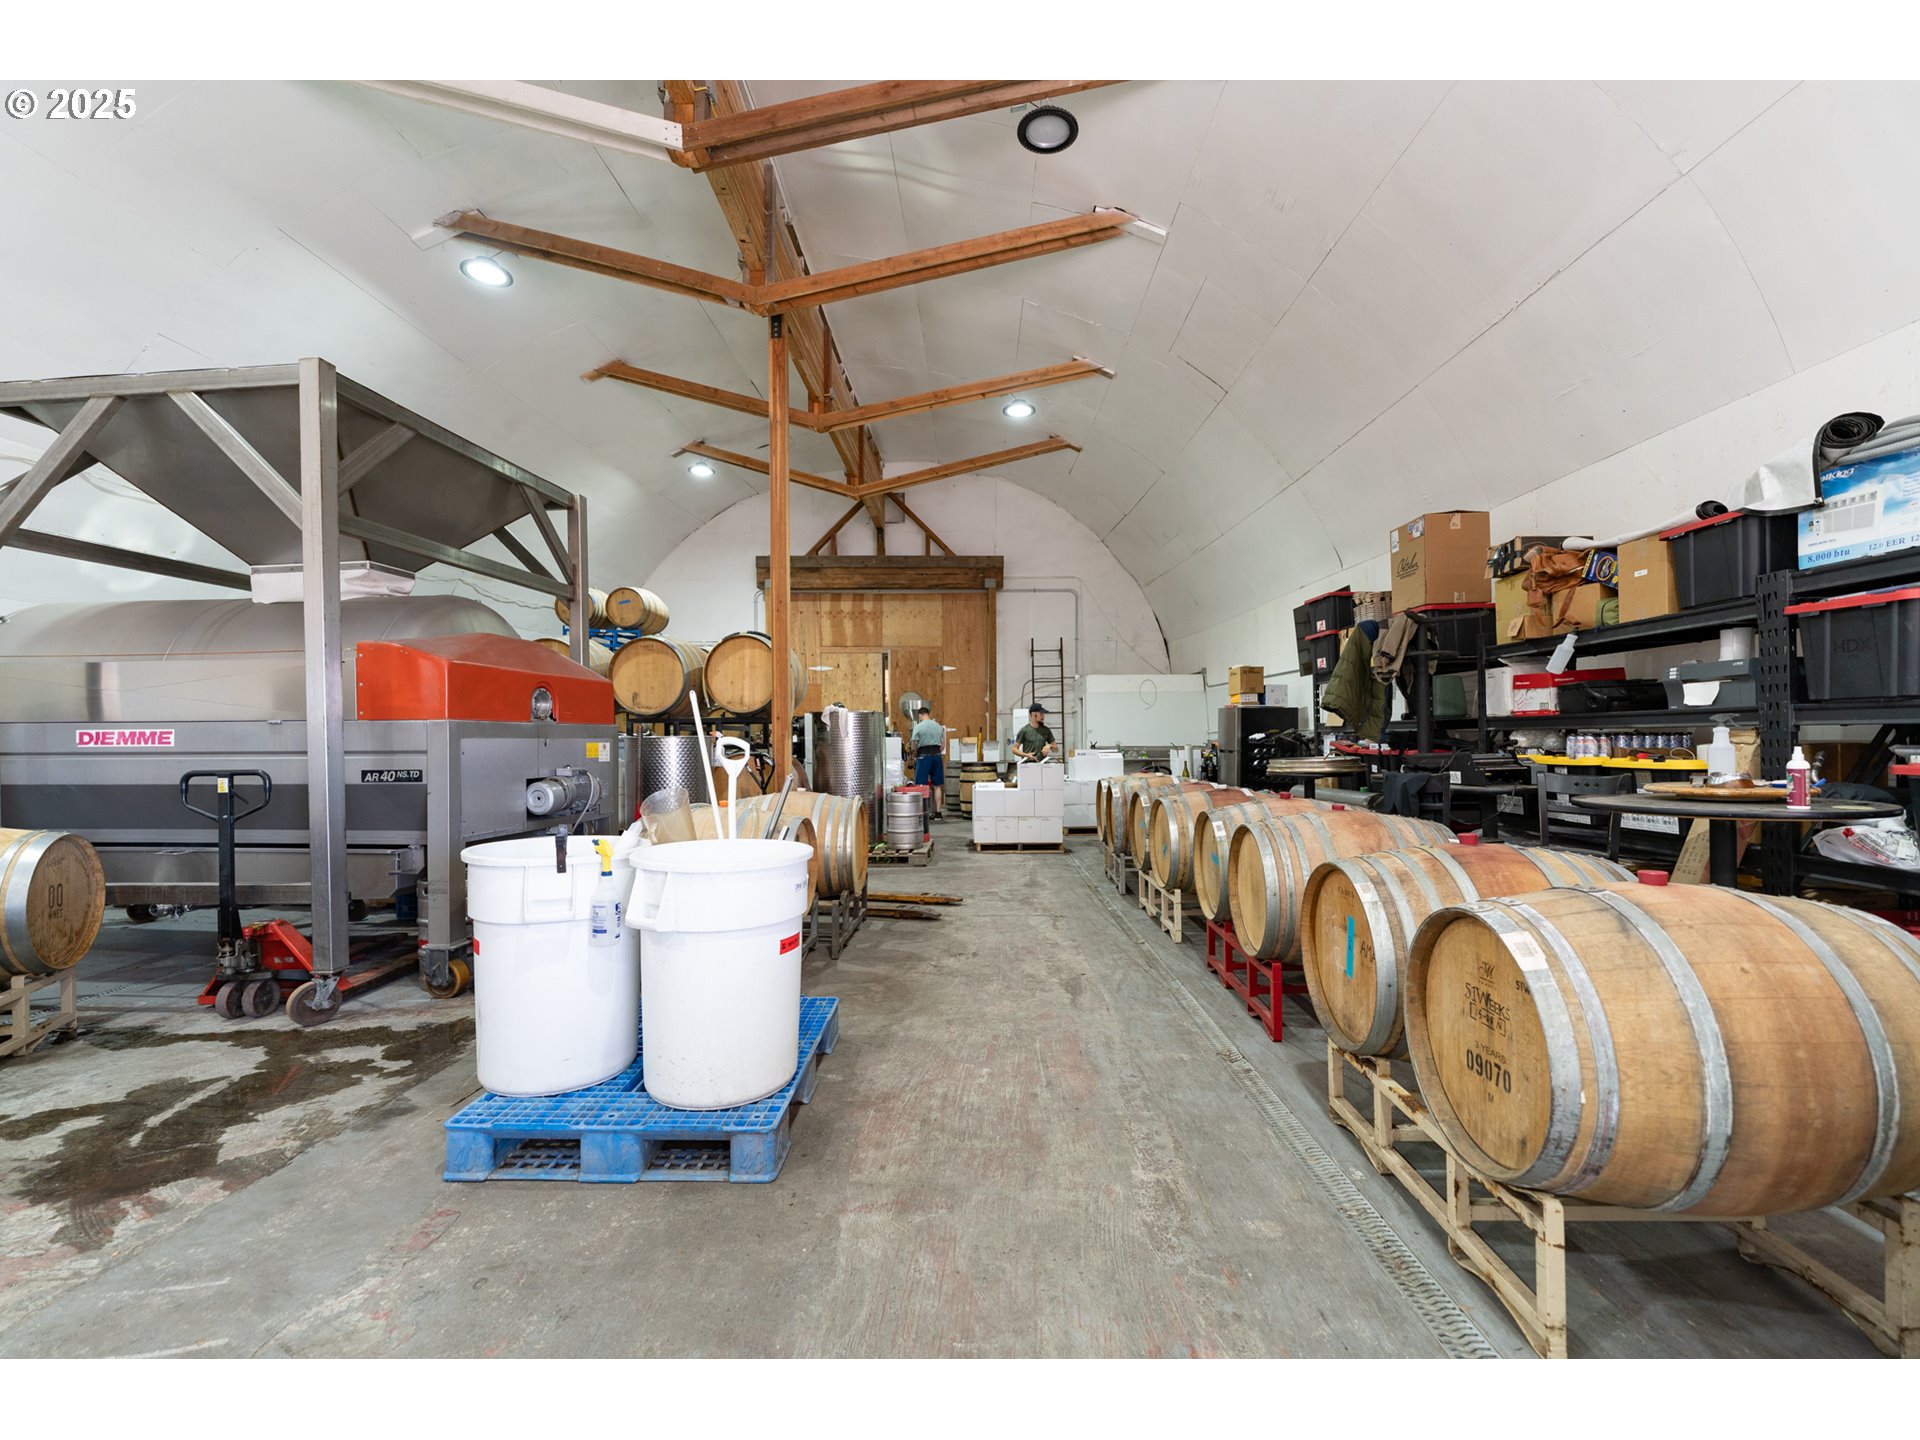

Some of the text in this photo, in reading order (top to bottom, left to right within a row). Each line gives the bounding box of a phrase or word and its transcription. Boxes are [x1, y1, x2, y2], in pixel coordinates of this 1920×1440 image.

[1834, 549, 1850, 558] btu
[1886, 537, 1905, 547] EER
[78, 731, 173, 745] DIEMME
[364, 772, 380, 782] AR
[380, 770, 396, 782] 40
[1473, 1040, 1480, 1049] 3
[1467, 1048, 1512, 1094] 09070
